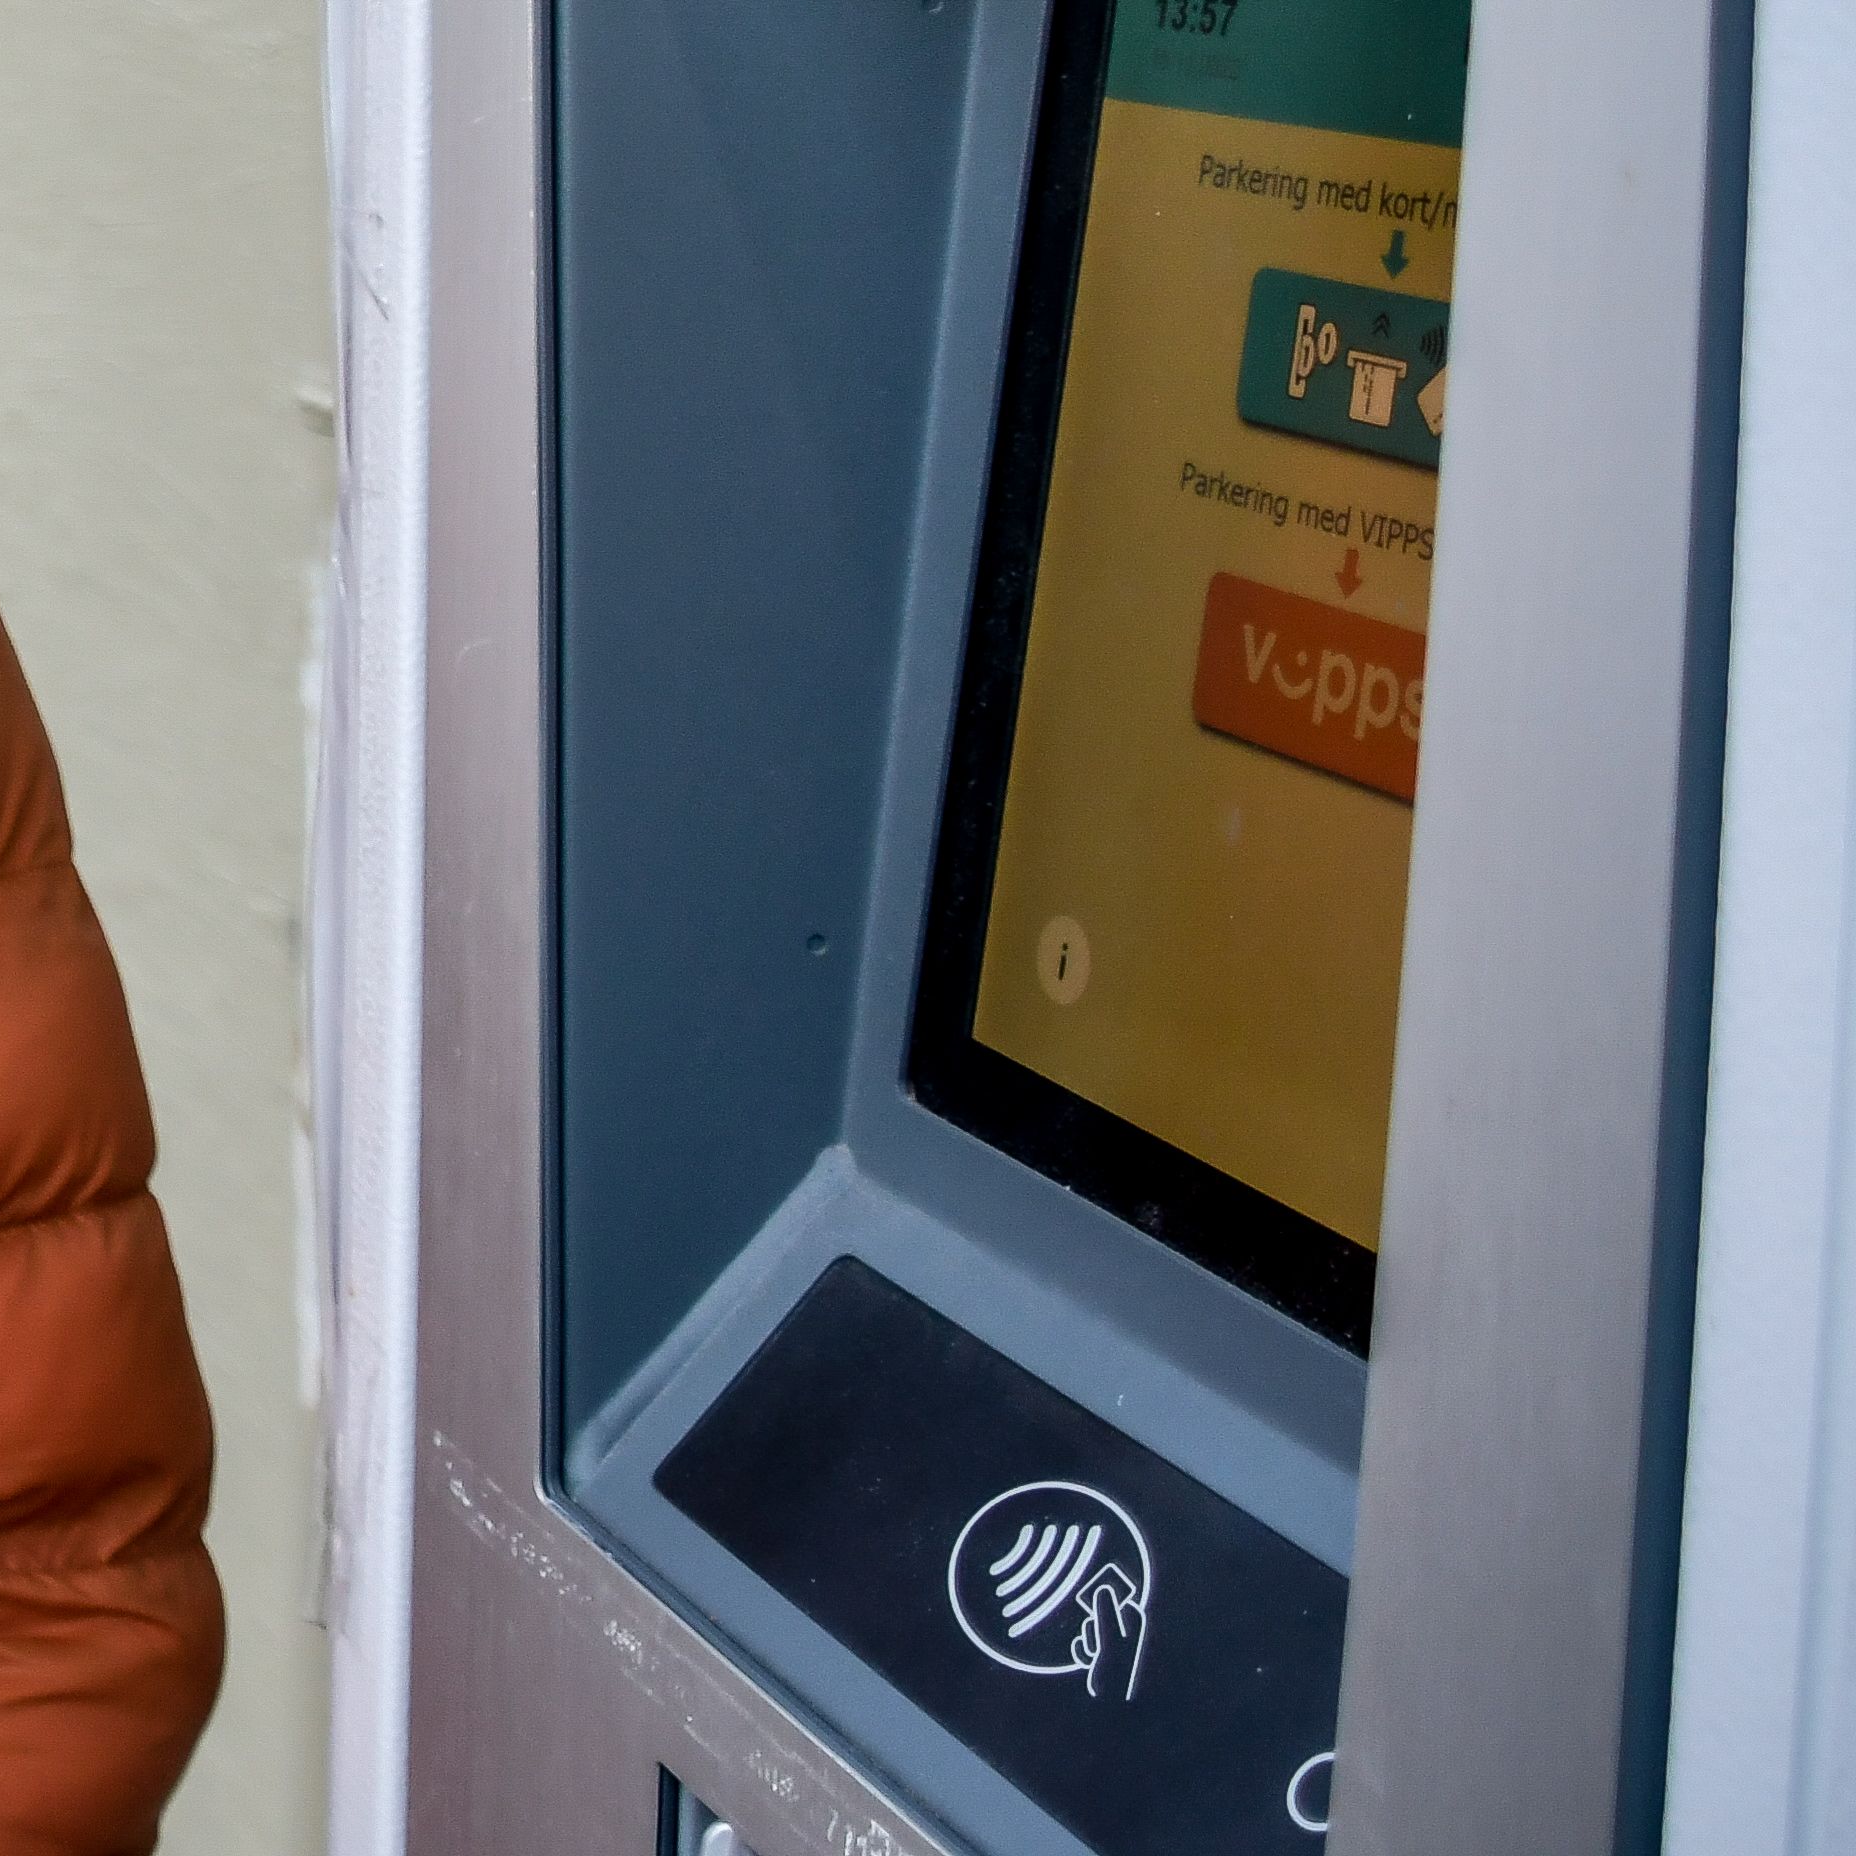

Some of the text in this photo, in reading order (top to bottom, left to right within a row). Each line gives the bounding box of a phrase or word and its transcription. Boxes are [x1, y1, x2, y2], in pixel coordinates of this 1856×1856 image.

[1198, 154, 1308, 211] Parkering
[1316, 180, 1372, 214] med
[1181, 462, 1435, 561] Parkering med VIPPS
